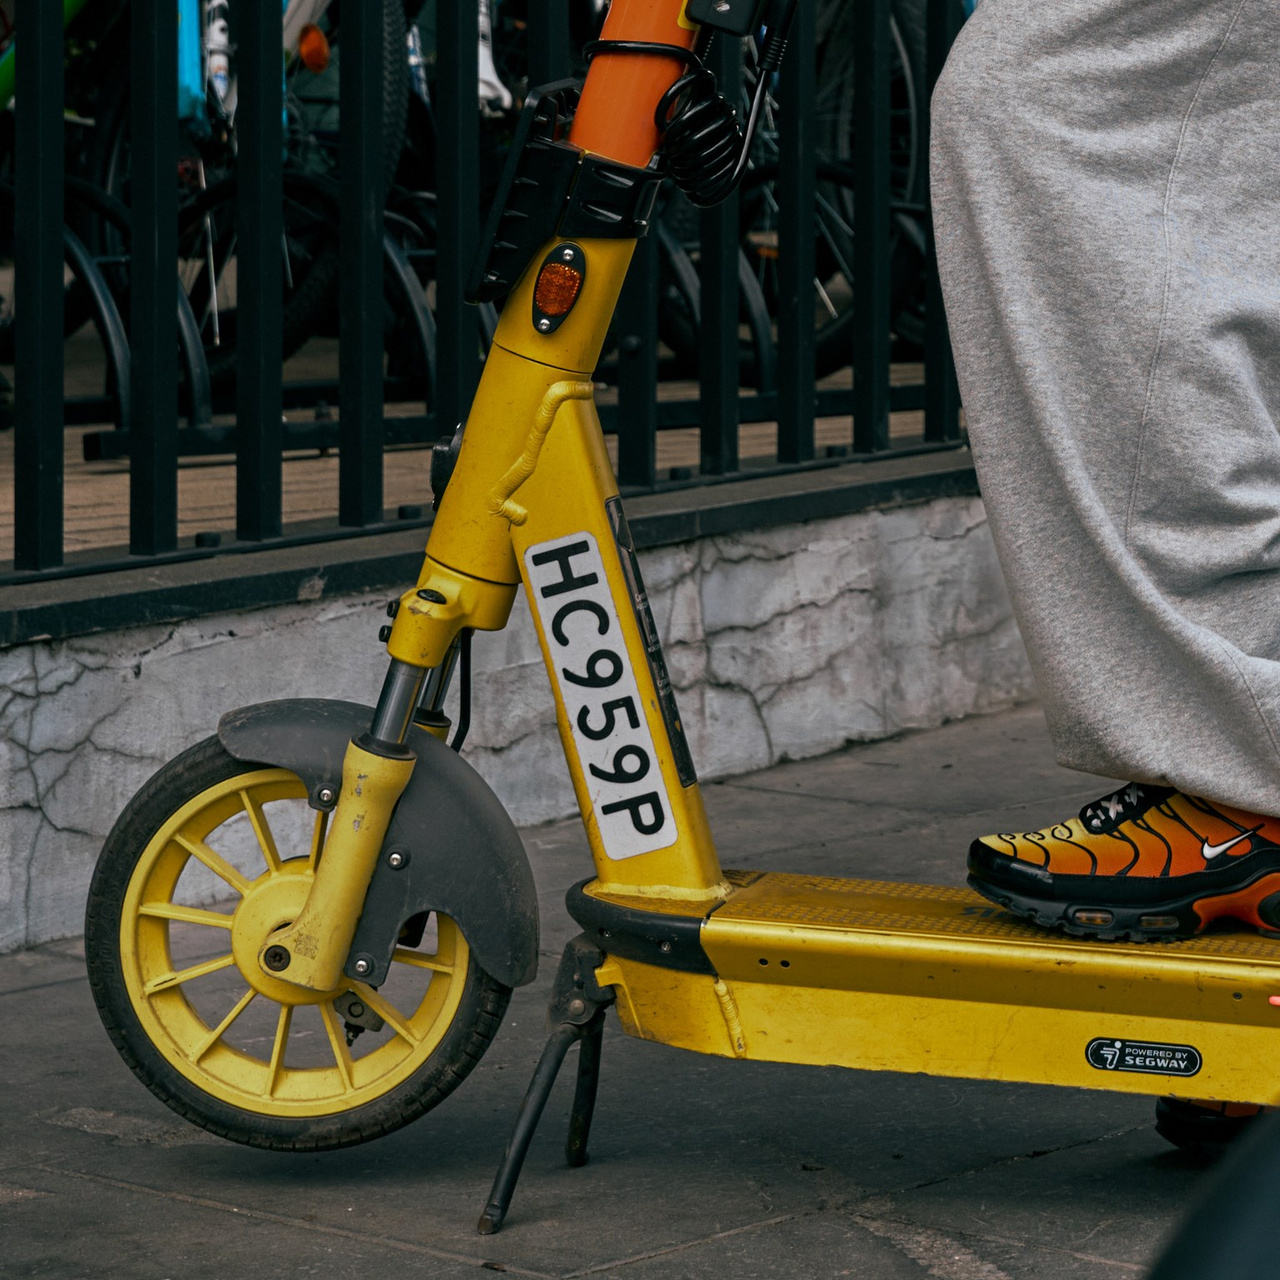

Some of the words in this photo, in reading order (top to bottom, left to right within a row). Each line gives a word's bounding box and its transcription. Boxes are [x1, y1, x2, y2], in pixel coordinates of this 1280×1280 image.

[1125, 1048, 1173, 1058] POWERED
[1175, 1051, 1188, 1059] BY
[1125, 1056, 1188, 1069] SEGWAY
